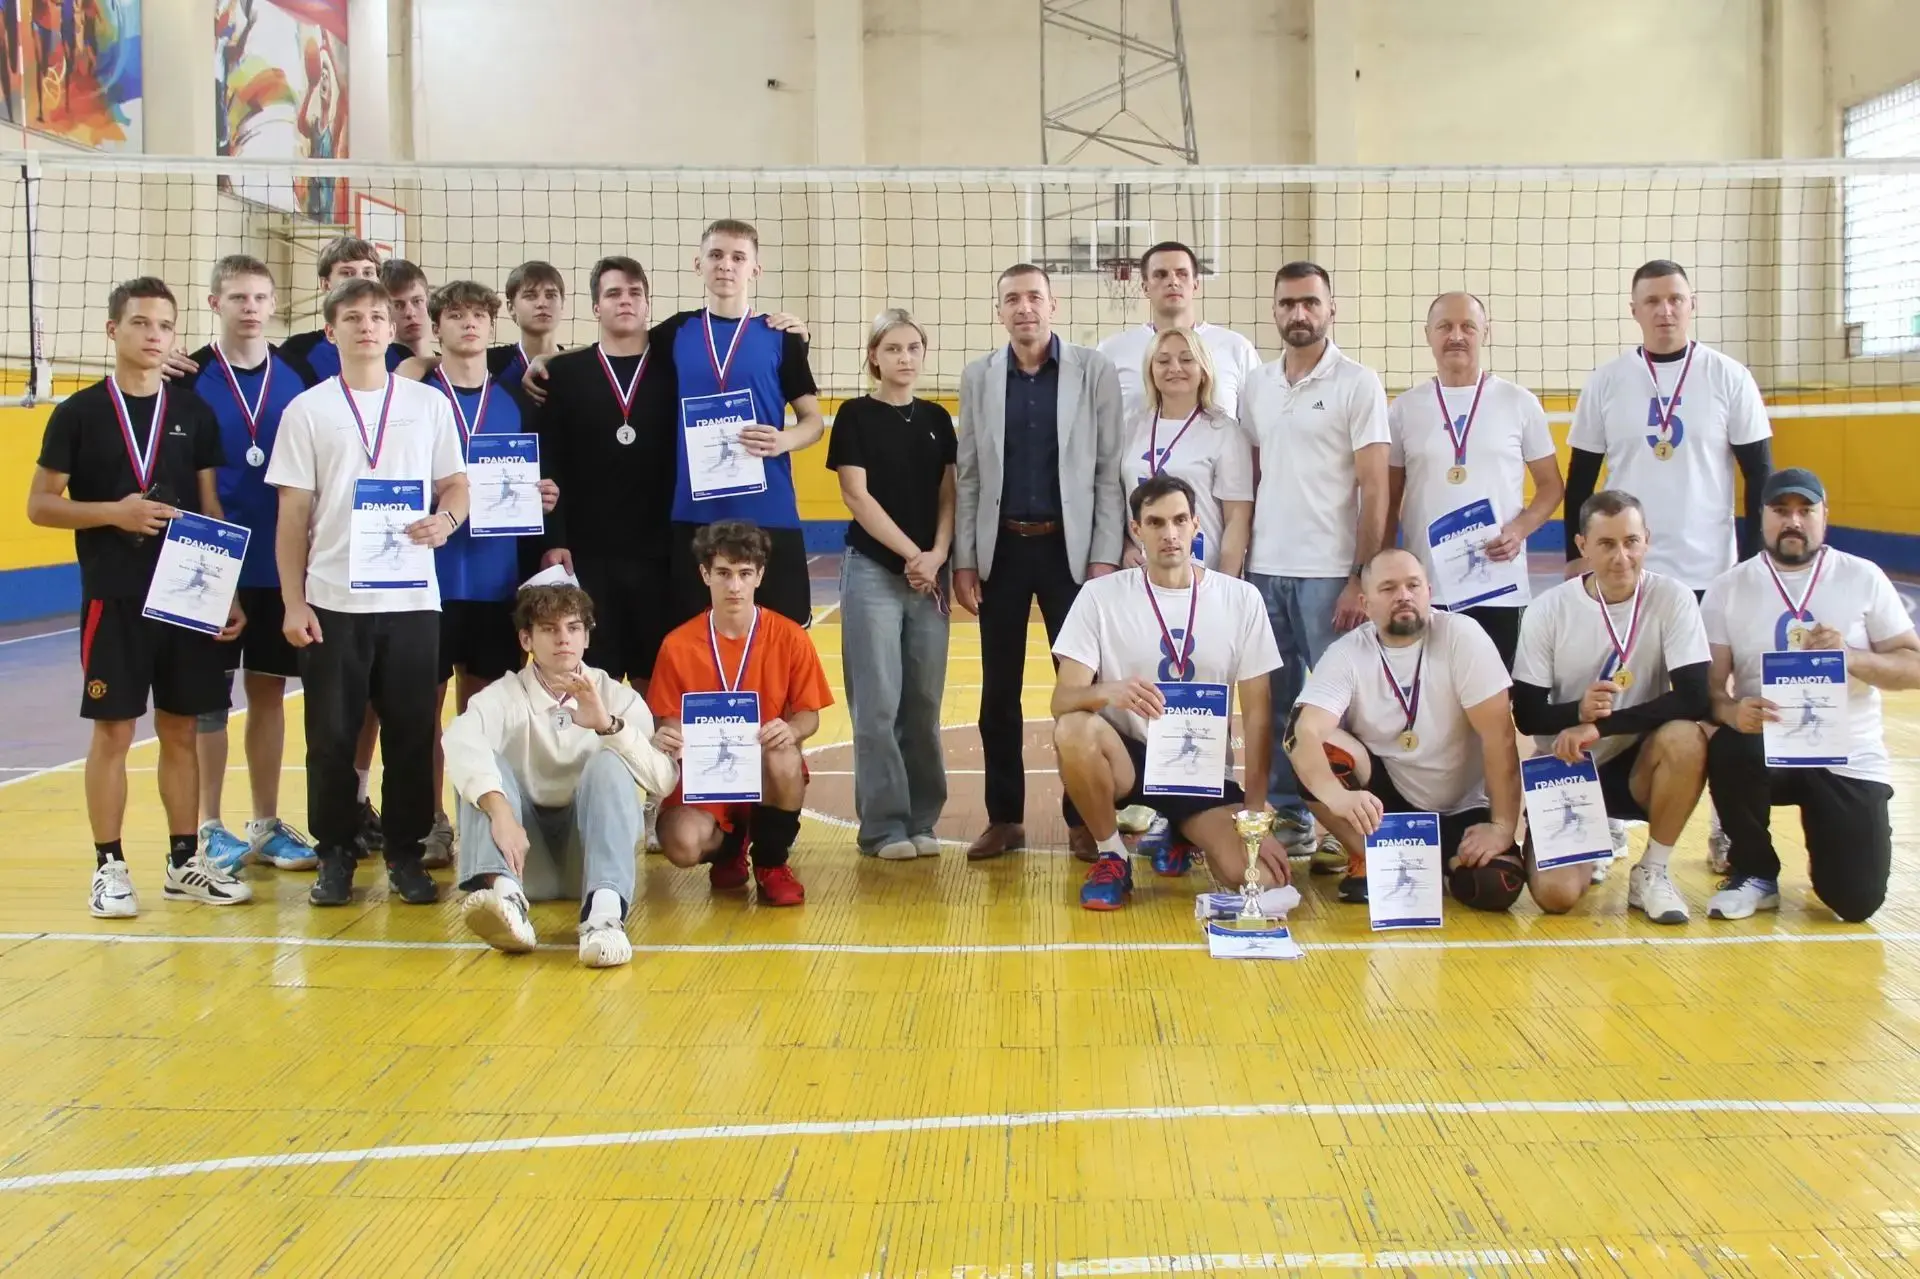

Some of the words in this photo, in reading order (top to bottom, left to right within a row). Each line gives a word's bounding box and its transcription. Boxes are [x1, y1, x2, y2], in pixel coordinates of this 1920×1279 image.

[696, 415, 744, 428] ГРАМОТА
[1646, 397, 1684, 450] 5
[478, 455, 527, 464] ГРАМОТА
[361, 502, 412, 511] ГРАМОТА
[1439, 521, 1486, 544] ГРАМОТА
[179, 535, 230, 558] ГРАМОТА
[1158, 628, 1196, 682] 8
[1775, 675, 1832, 685] ГРАМОТА
[694, 715, 747, 725] ГРАМОТА
[1534, 775, 1587, 791] ГРАМОТА
[1376, 838, 1427, 848] ГРАМОТА
